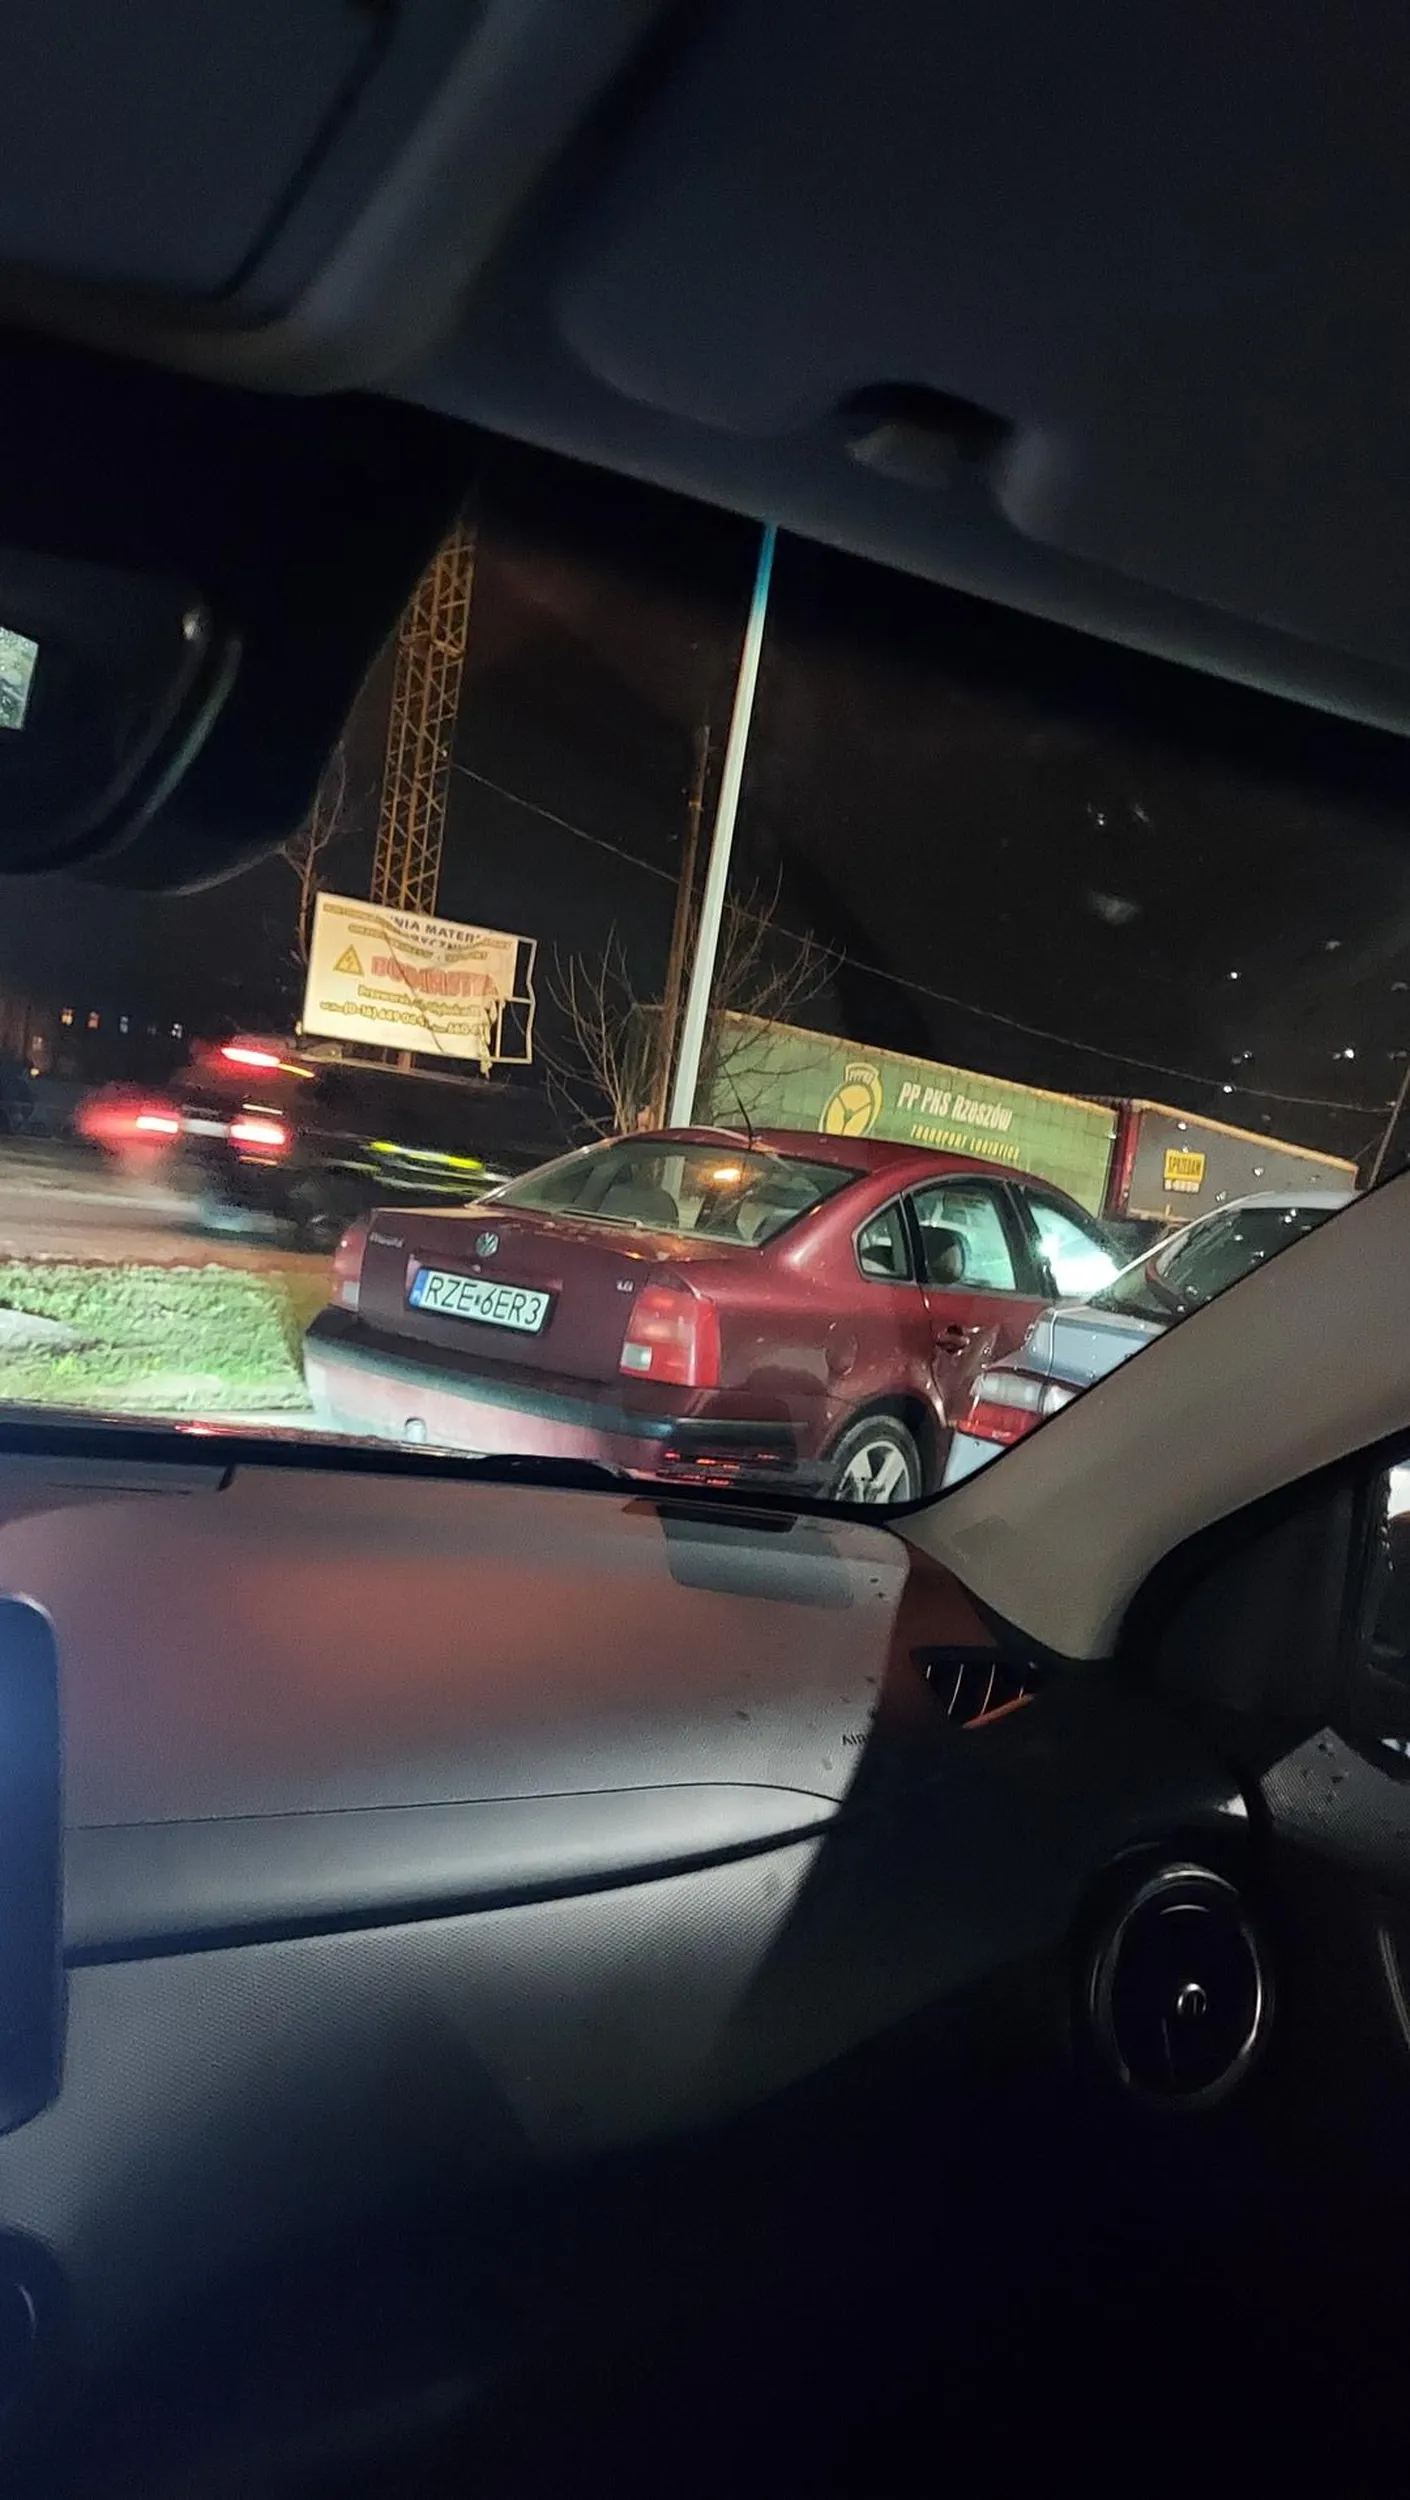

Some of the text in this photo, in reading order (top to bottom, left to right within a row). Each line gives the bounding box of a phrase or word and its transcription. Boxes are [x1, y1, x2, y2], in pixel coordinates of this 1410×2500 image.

[897, 1082, 1013, 1132] PP PKS Rzeszów
[425, 1276, 541, 1325] RZE 6ER3
